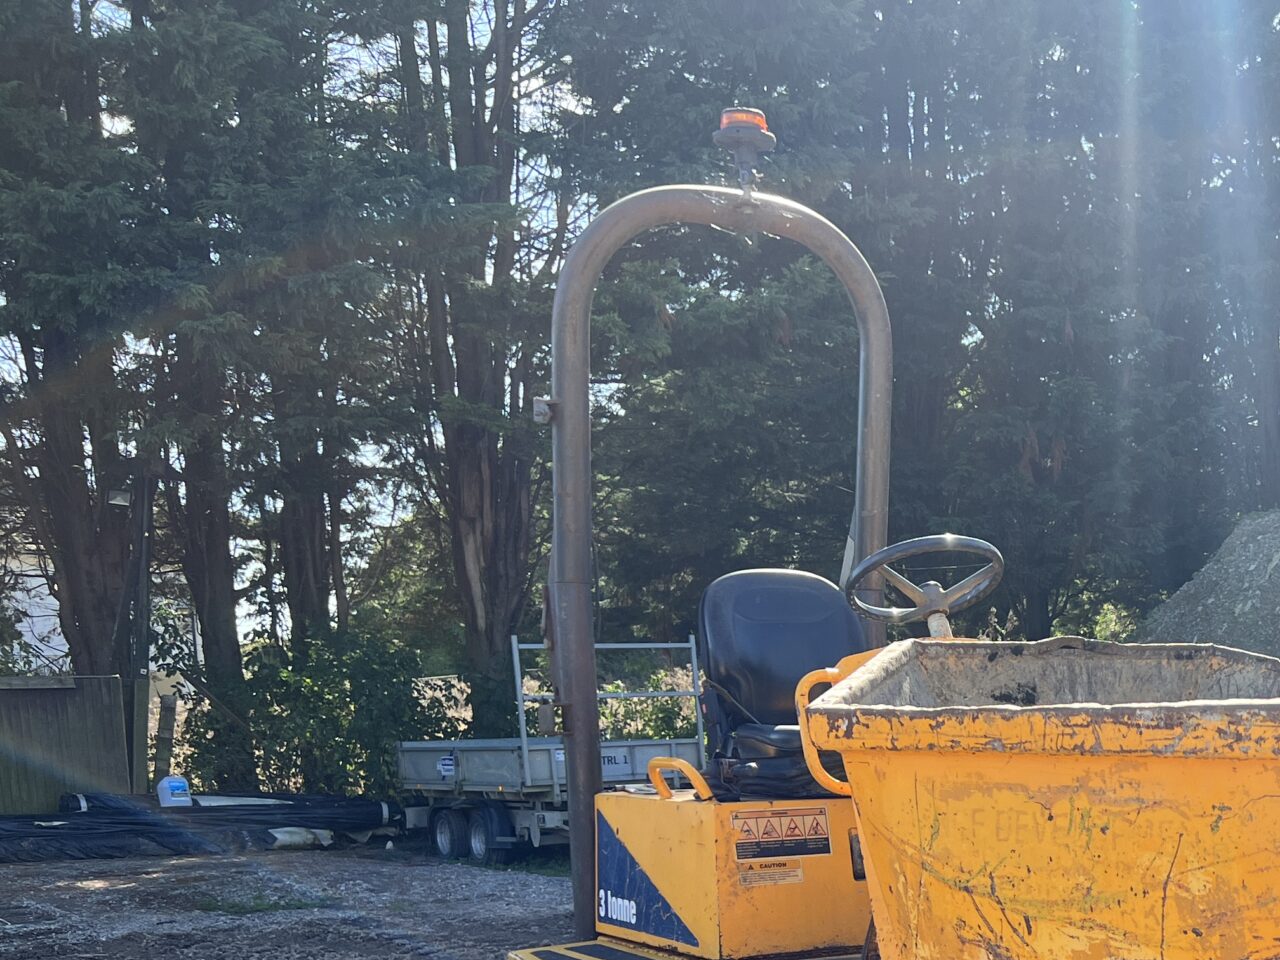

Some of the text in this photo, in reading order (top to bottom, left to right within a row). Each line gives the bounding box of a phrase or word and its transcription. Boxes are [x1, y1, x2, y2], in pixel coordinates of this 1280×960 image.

[602, 755, 629, 765] TRL 1
[599, 889, 637, 924] 3 tonne
